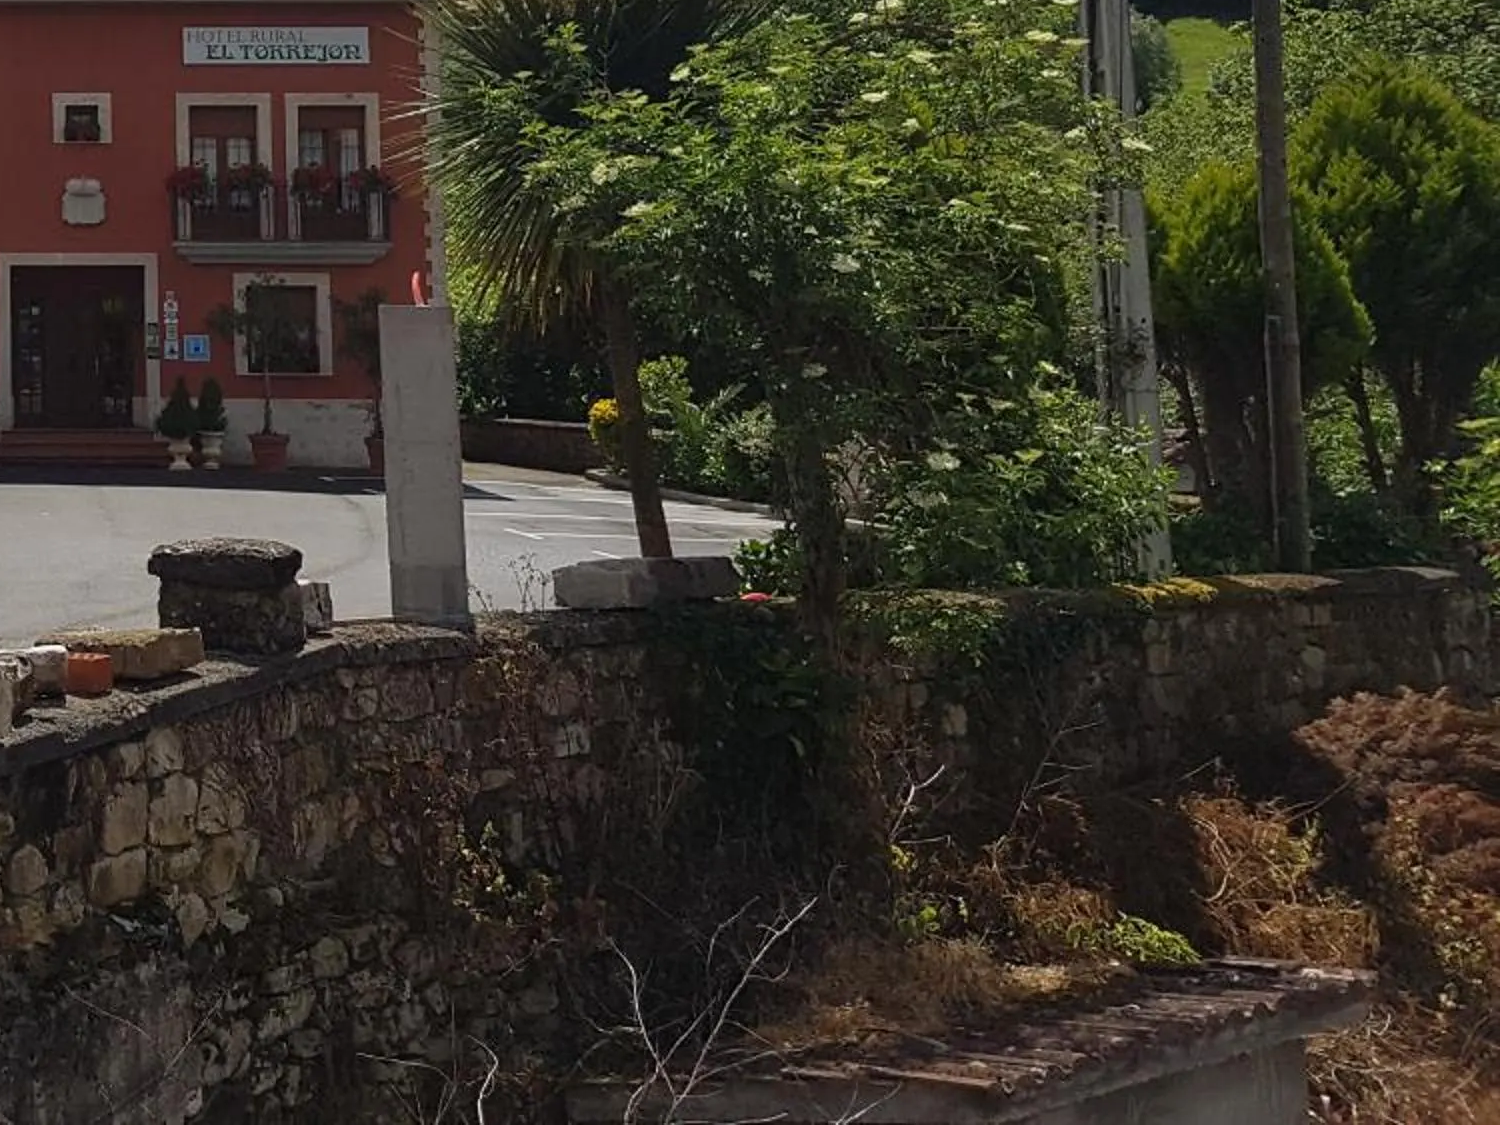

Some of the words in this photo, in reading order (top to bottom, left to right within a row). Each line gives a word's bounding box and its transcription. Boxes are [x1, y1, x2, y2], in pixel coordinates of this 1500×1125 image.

[186, 29, 244, 43] HOTEL
[250, 29, 307, 43] RURAL
[205, 44, 234, 60] EL
